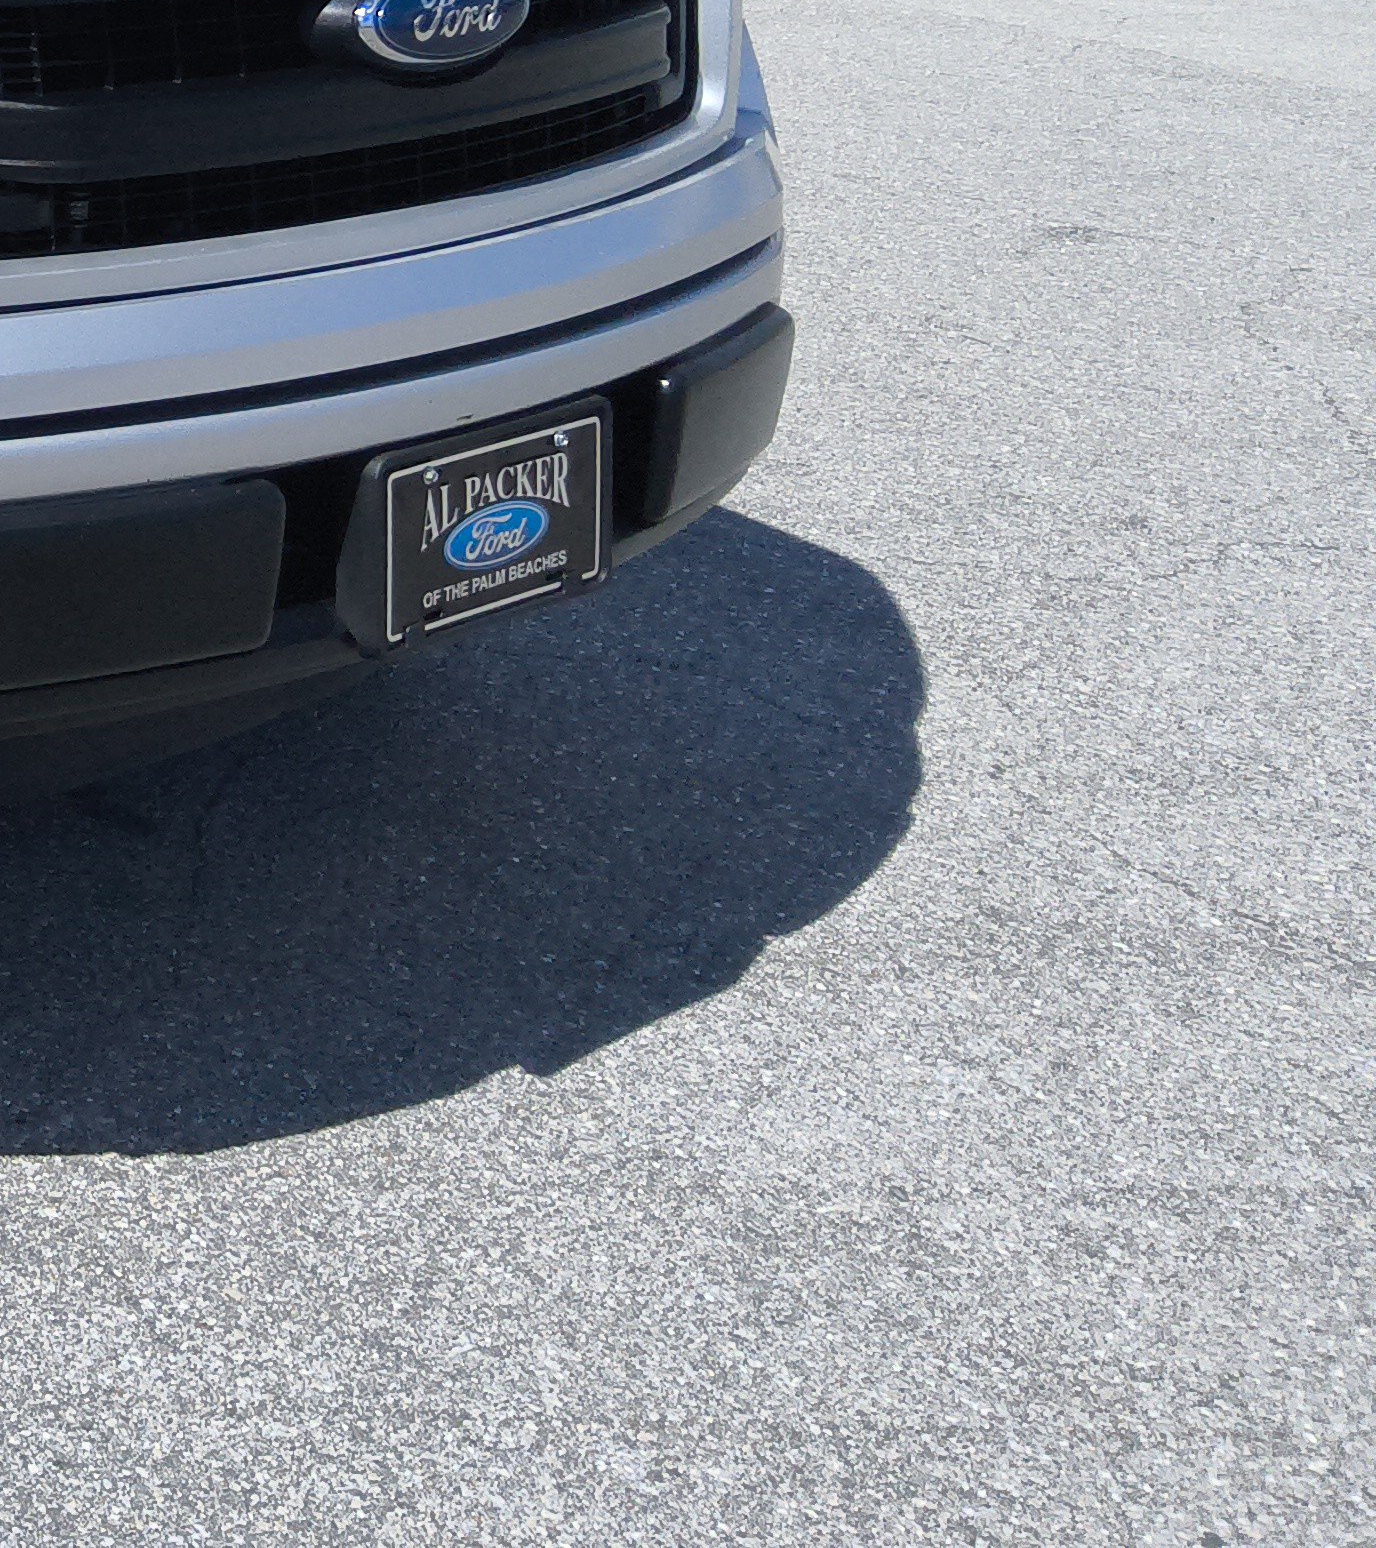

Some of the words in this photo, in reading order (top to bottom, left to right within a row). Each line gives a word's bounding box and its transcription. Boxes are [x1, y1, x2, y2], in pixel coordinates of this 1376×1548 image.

[420, 483, 460, 552] AL
[464, 452, 570, 514] PACKER
[465, 512, 527, 560] Ford
[423, 590, 443, 608] OF
[444, 579, 469, 603] THE
[472, 569, 505, 594] PALM
[508, 549, 568, 582] BEACHES
